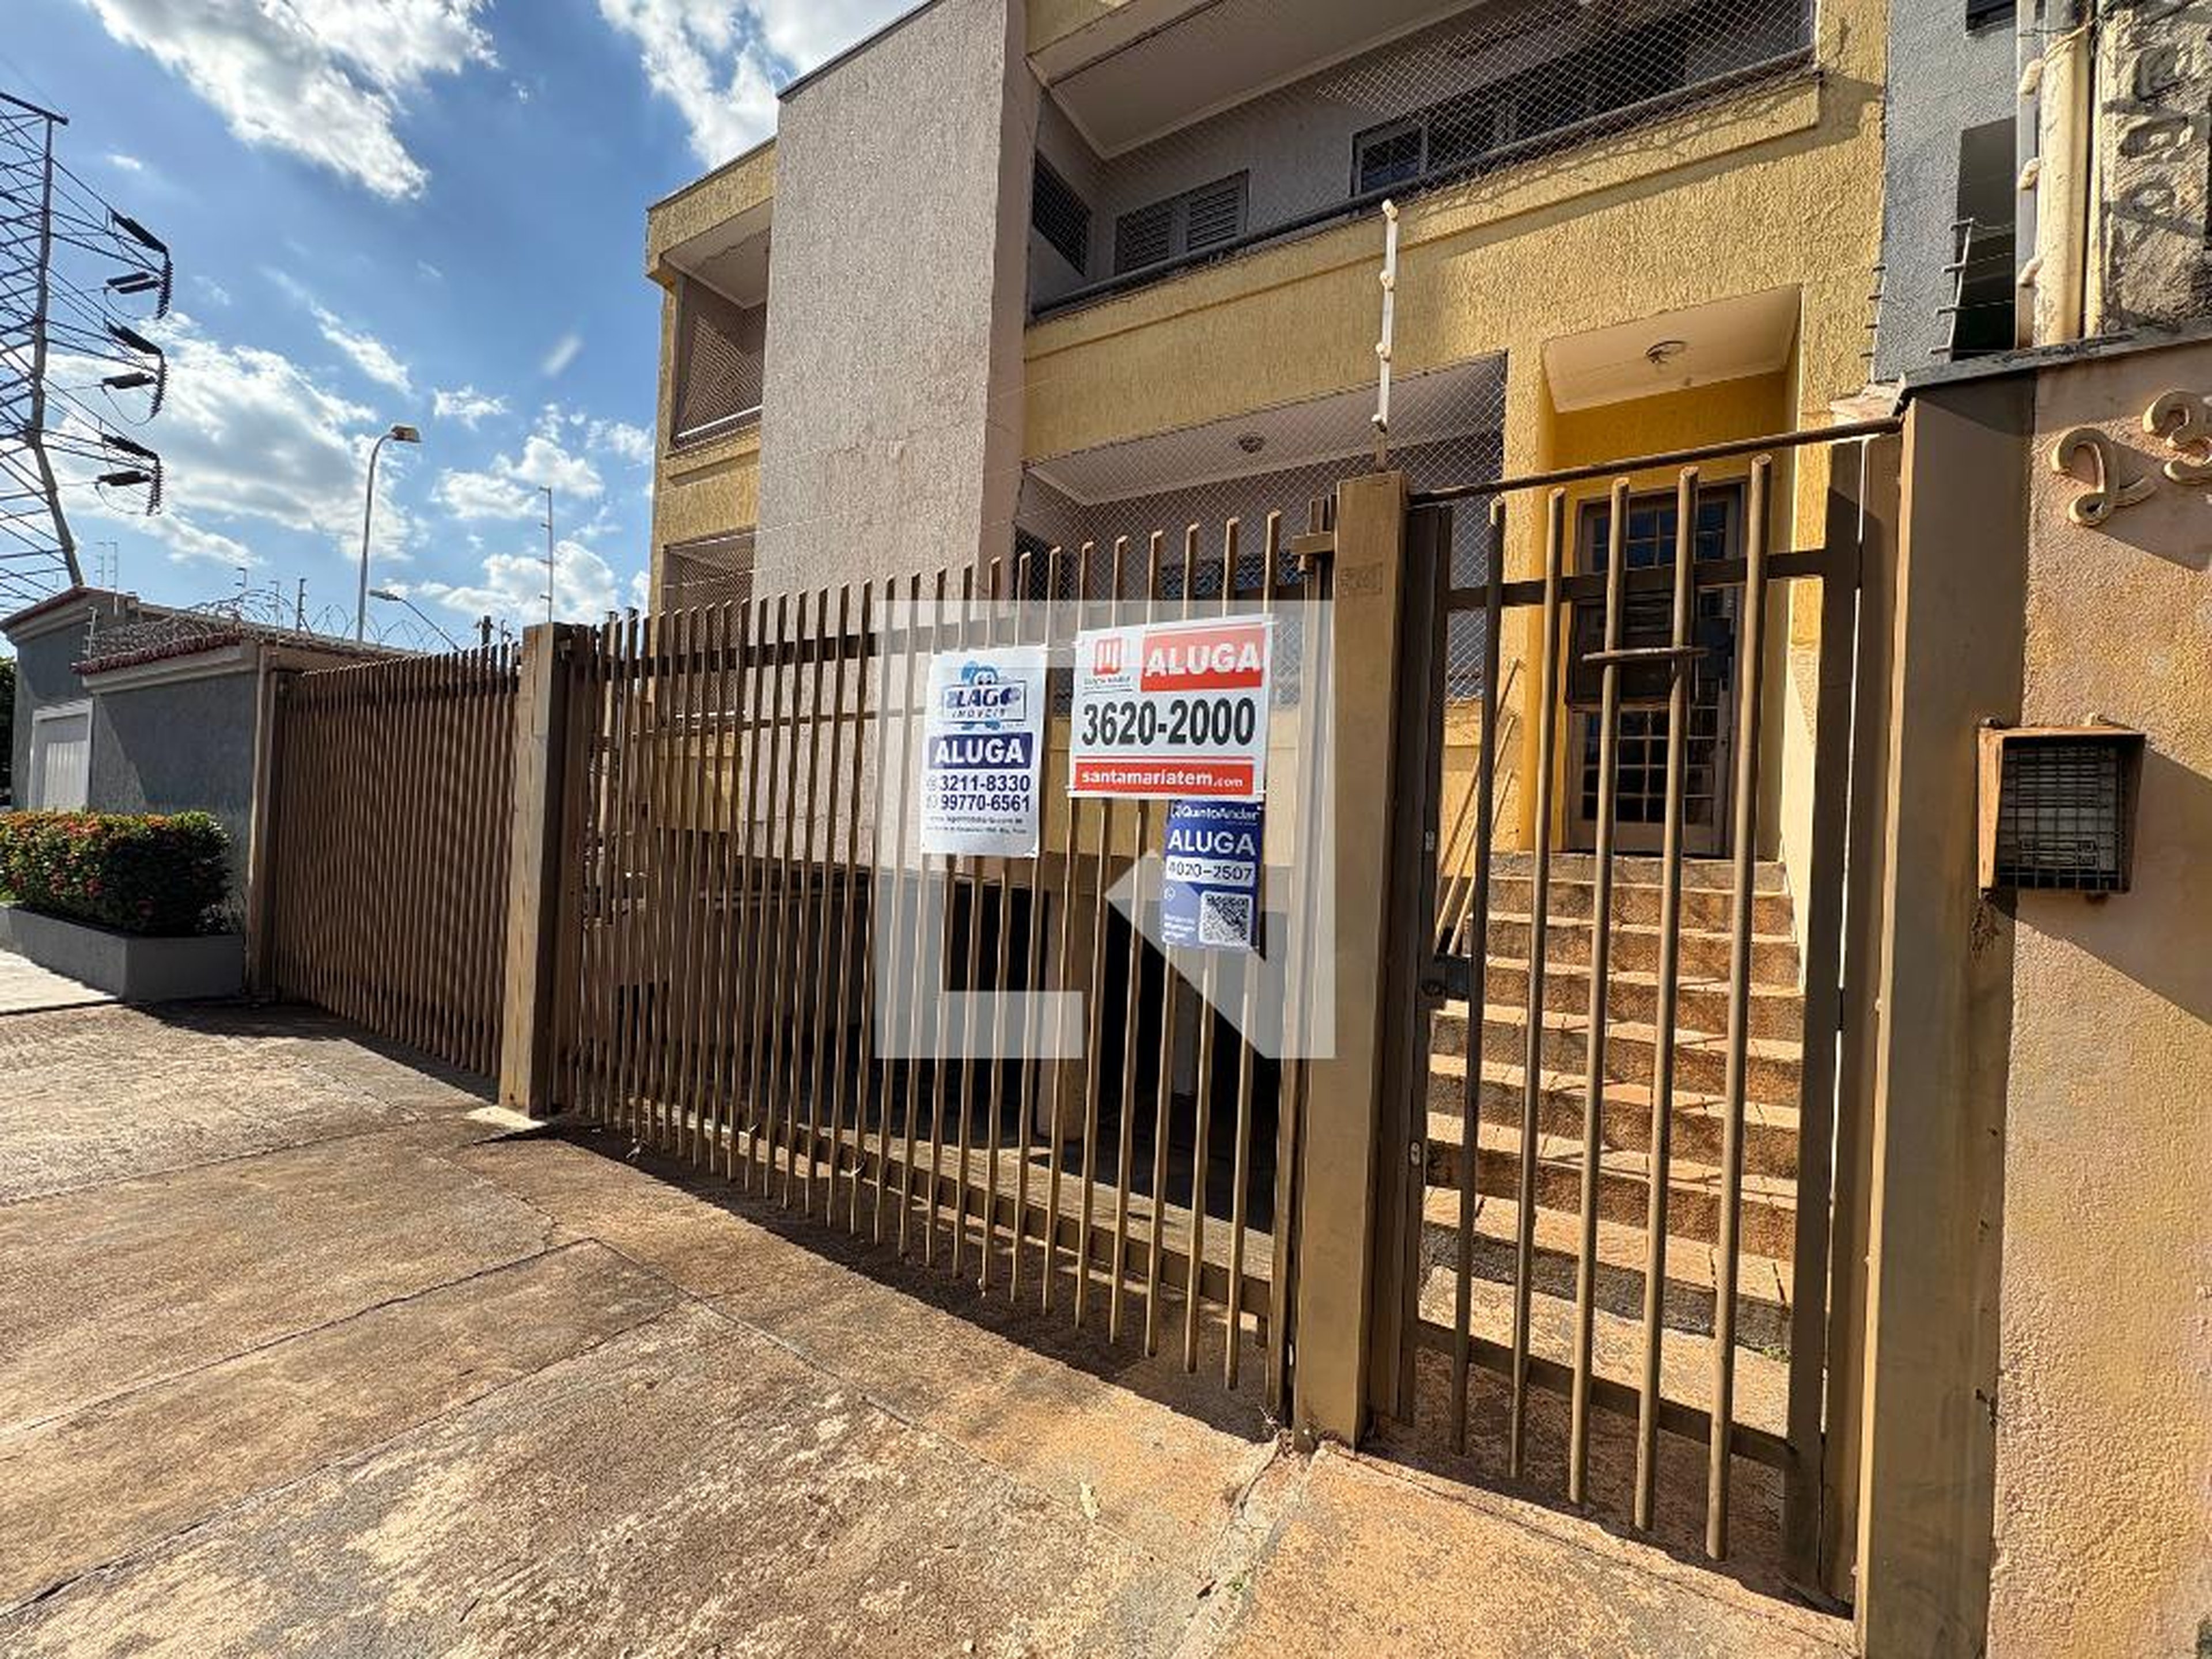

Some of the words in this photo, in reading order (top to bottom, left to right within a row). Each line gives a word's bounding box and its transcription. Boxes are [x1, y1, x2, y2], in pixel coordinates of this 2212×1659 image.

[1145, 641, 1260, 677] ALUGA
[1082, 698, 1255, 746] 3620-2000
[934, 738, 1024, 764] ALUGA
[940, 775, 1031, 792] 3211-8330
[1082, 768, 1244, 787] santamariatem.com
[941, 794, 1030, 812] 99770-6561
[1168, 829, 1256, 857] ALUGA
[1168, 861, 1253, 881] 4020-2507
